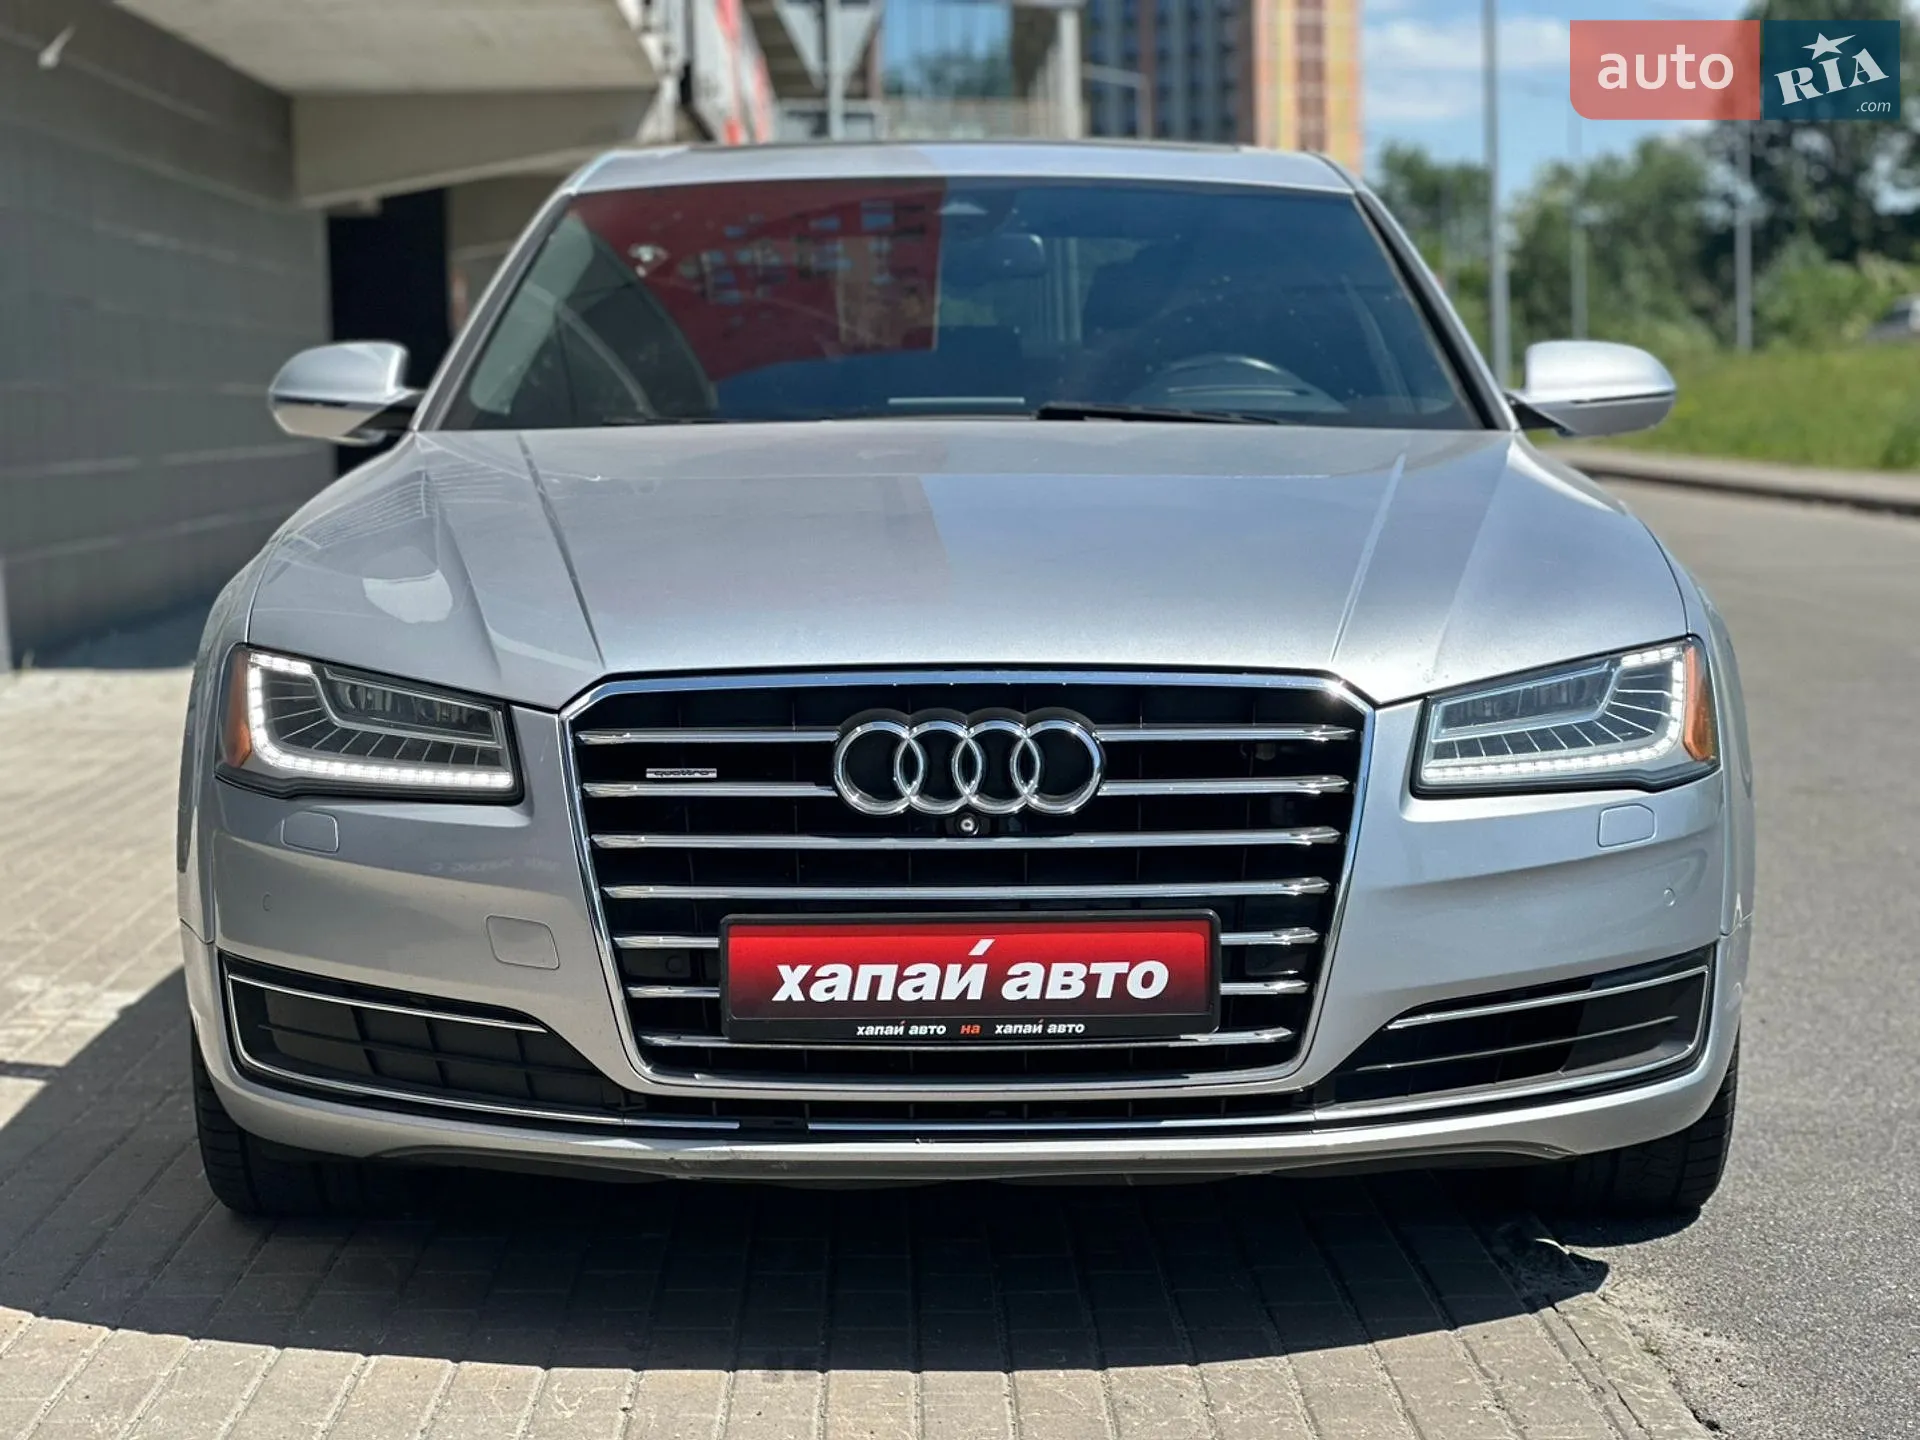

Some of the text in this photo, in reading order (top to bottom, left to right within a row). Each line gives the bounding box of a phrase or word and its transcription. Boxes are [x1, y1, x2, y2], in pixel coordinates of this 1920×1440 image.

[1001, 960, 1169, 1001] авто
[908, 1024, 947, 1036] авто
[960, 1024, 981, 1035] на
[1046, 1023, 1086, 1034] авто
